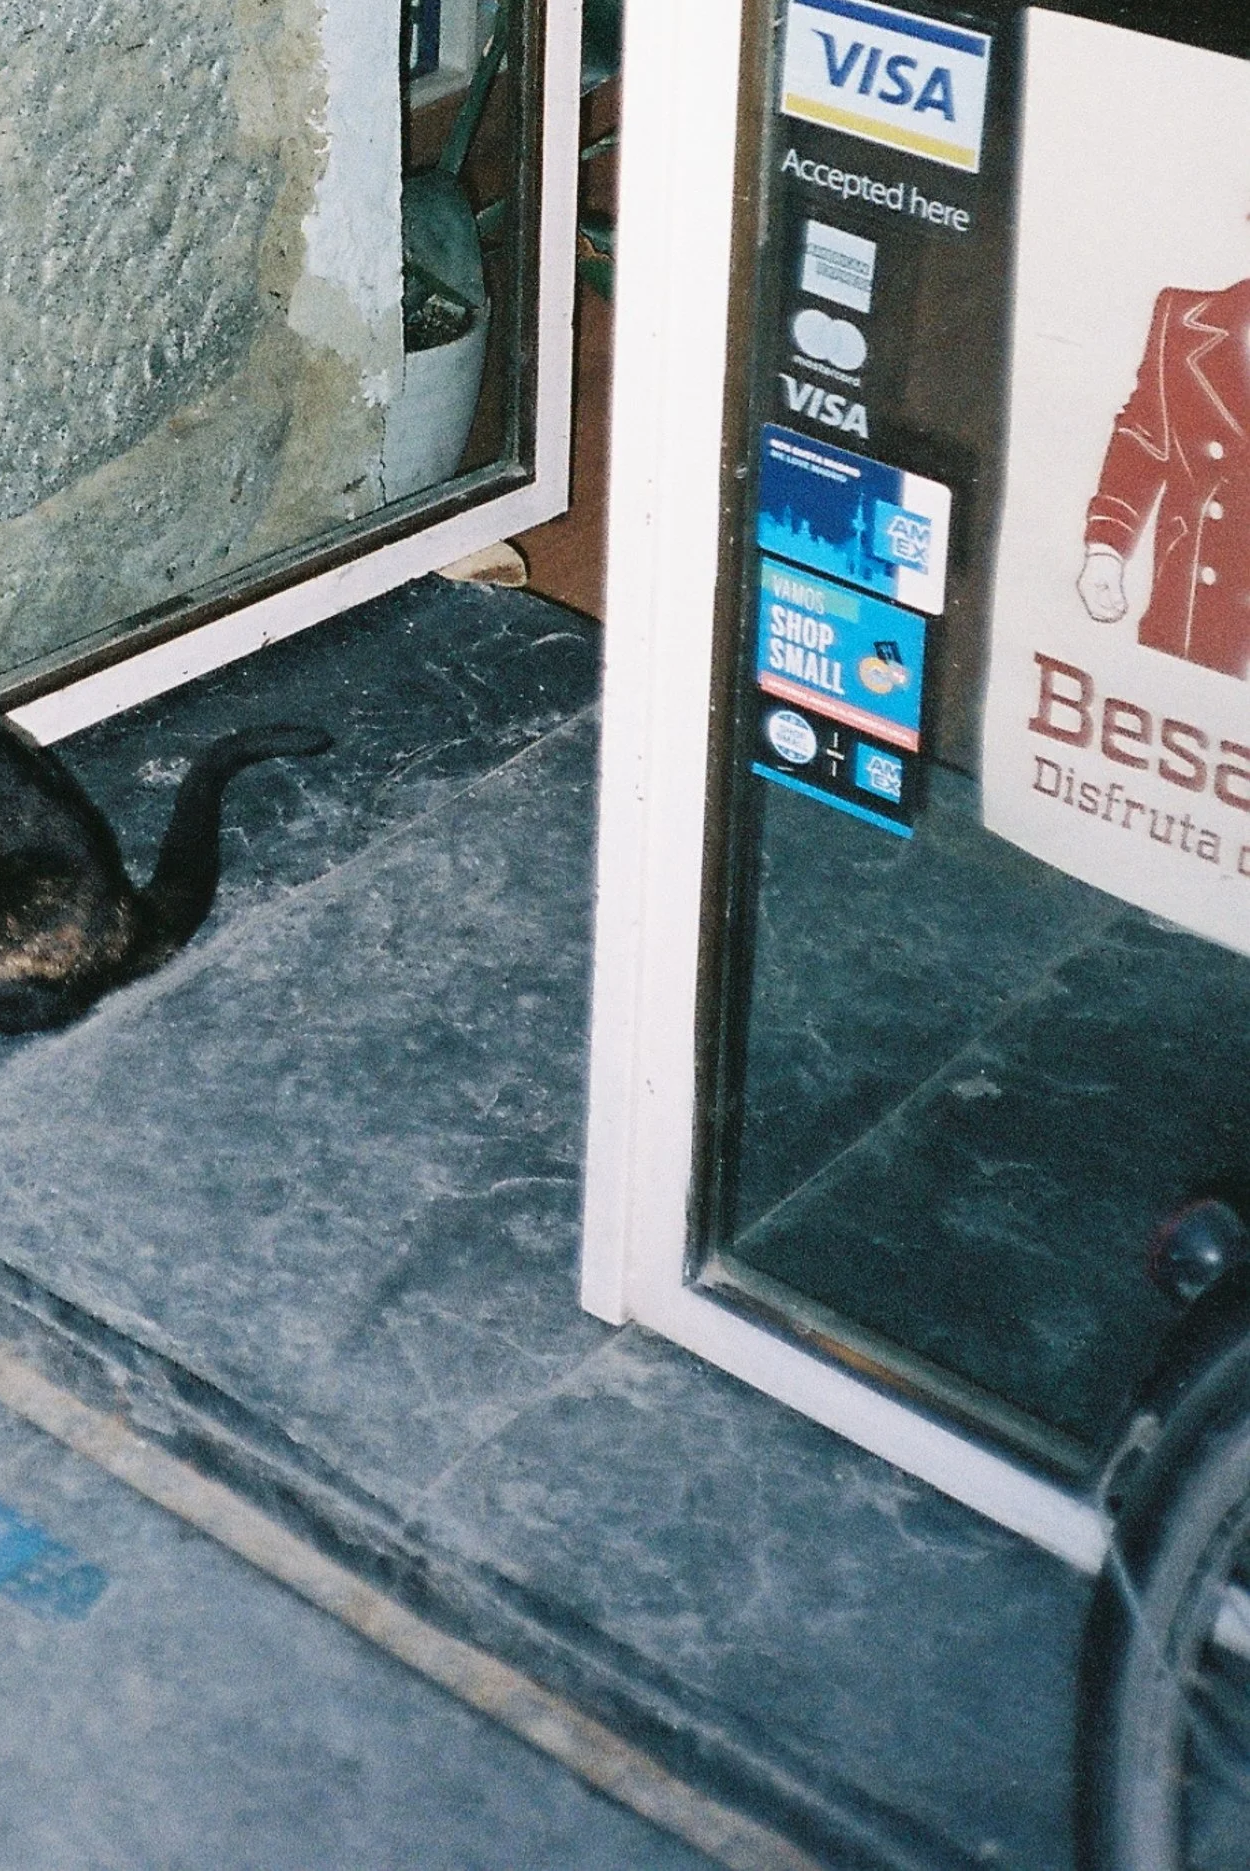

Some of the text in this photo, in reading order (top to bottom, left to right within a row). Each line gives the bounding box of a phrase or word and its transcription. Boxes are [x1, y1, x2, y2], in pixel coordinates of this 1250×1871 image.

[811, 28, 956, 123] VISA
[781, 148, 970, 232] Accepted here
[779, 374, 869, 439] VISA
[771, 574, 825, 615] VAMOS
[770, 603, 834, 654] SHOP
[770, 637, 845, 696] SMALL
[1032, 755, 1221, 865] Disfruta
